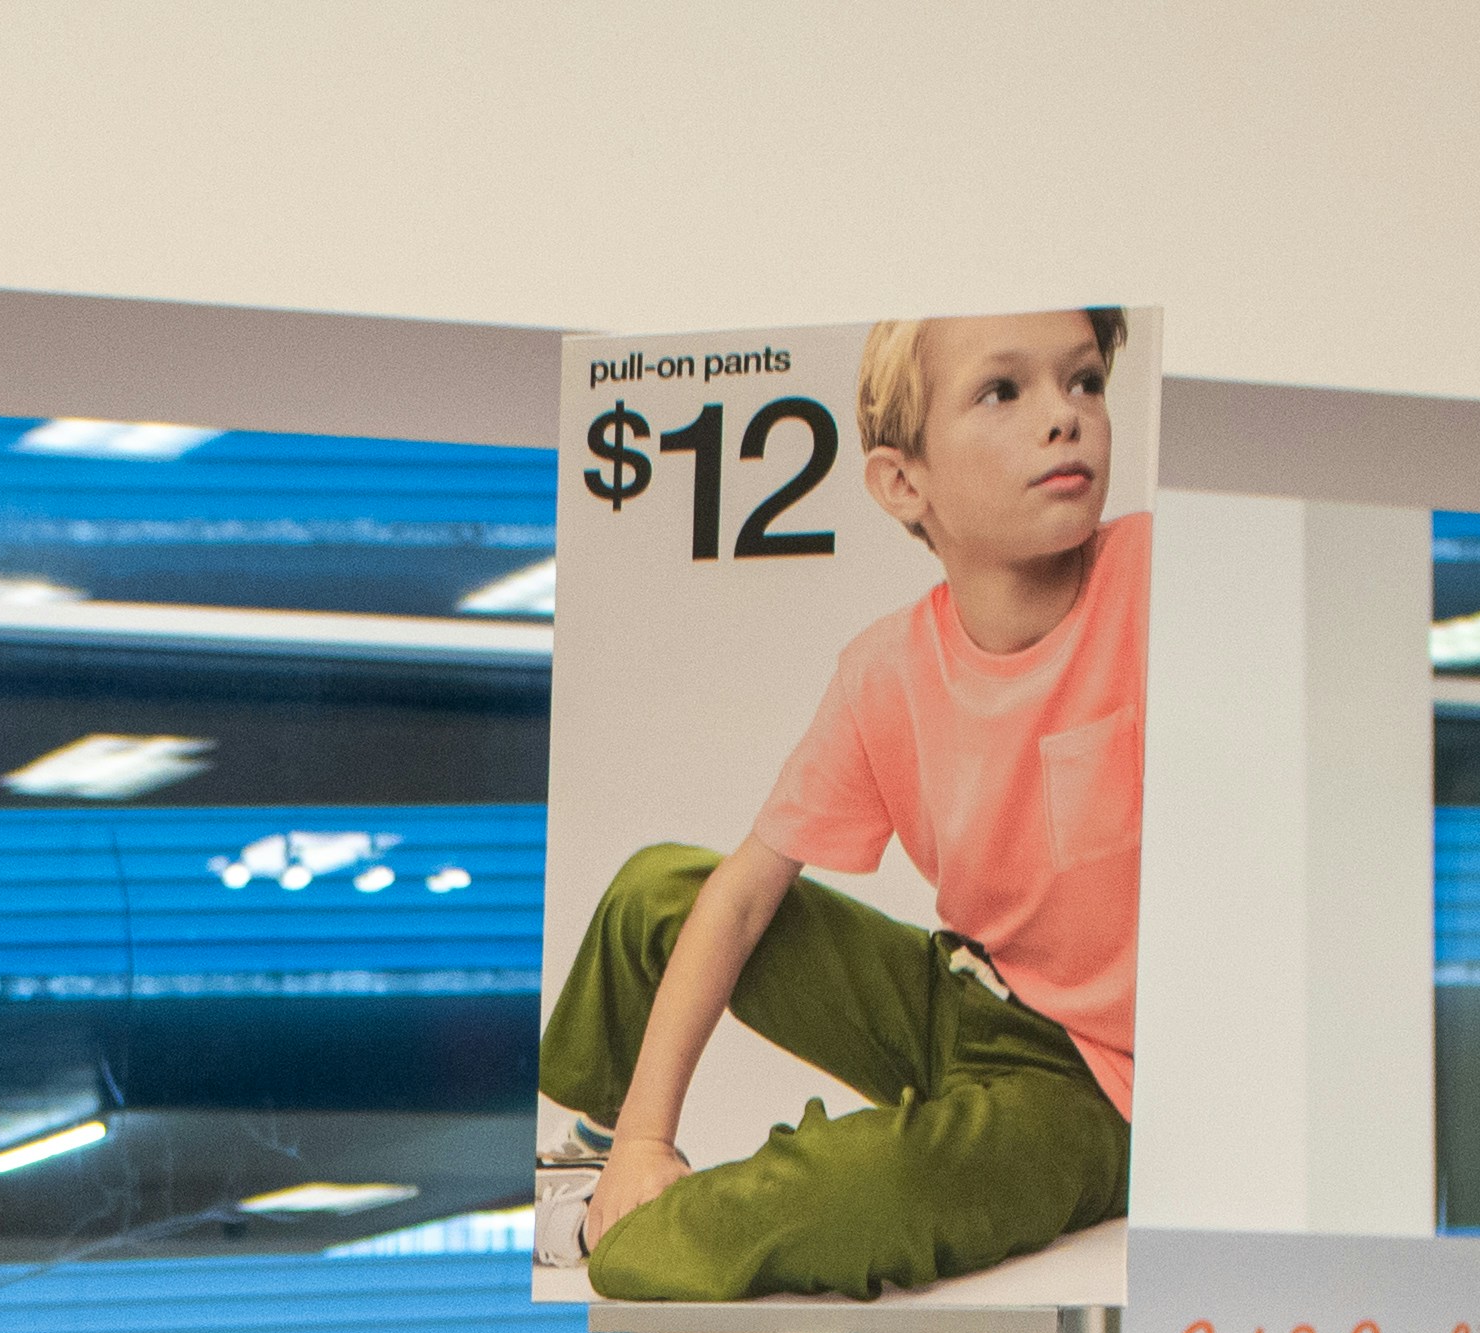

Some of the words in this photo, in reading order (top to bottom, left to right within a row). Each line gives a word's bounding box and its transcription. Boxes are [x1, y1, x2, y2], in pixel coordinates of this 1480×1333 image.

[589, 351, 694, 389] pull-on
[704, 346, 792, 382] pants
[583, 396, 839, 562] $12
